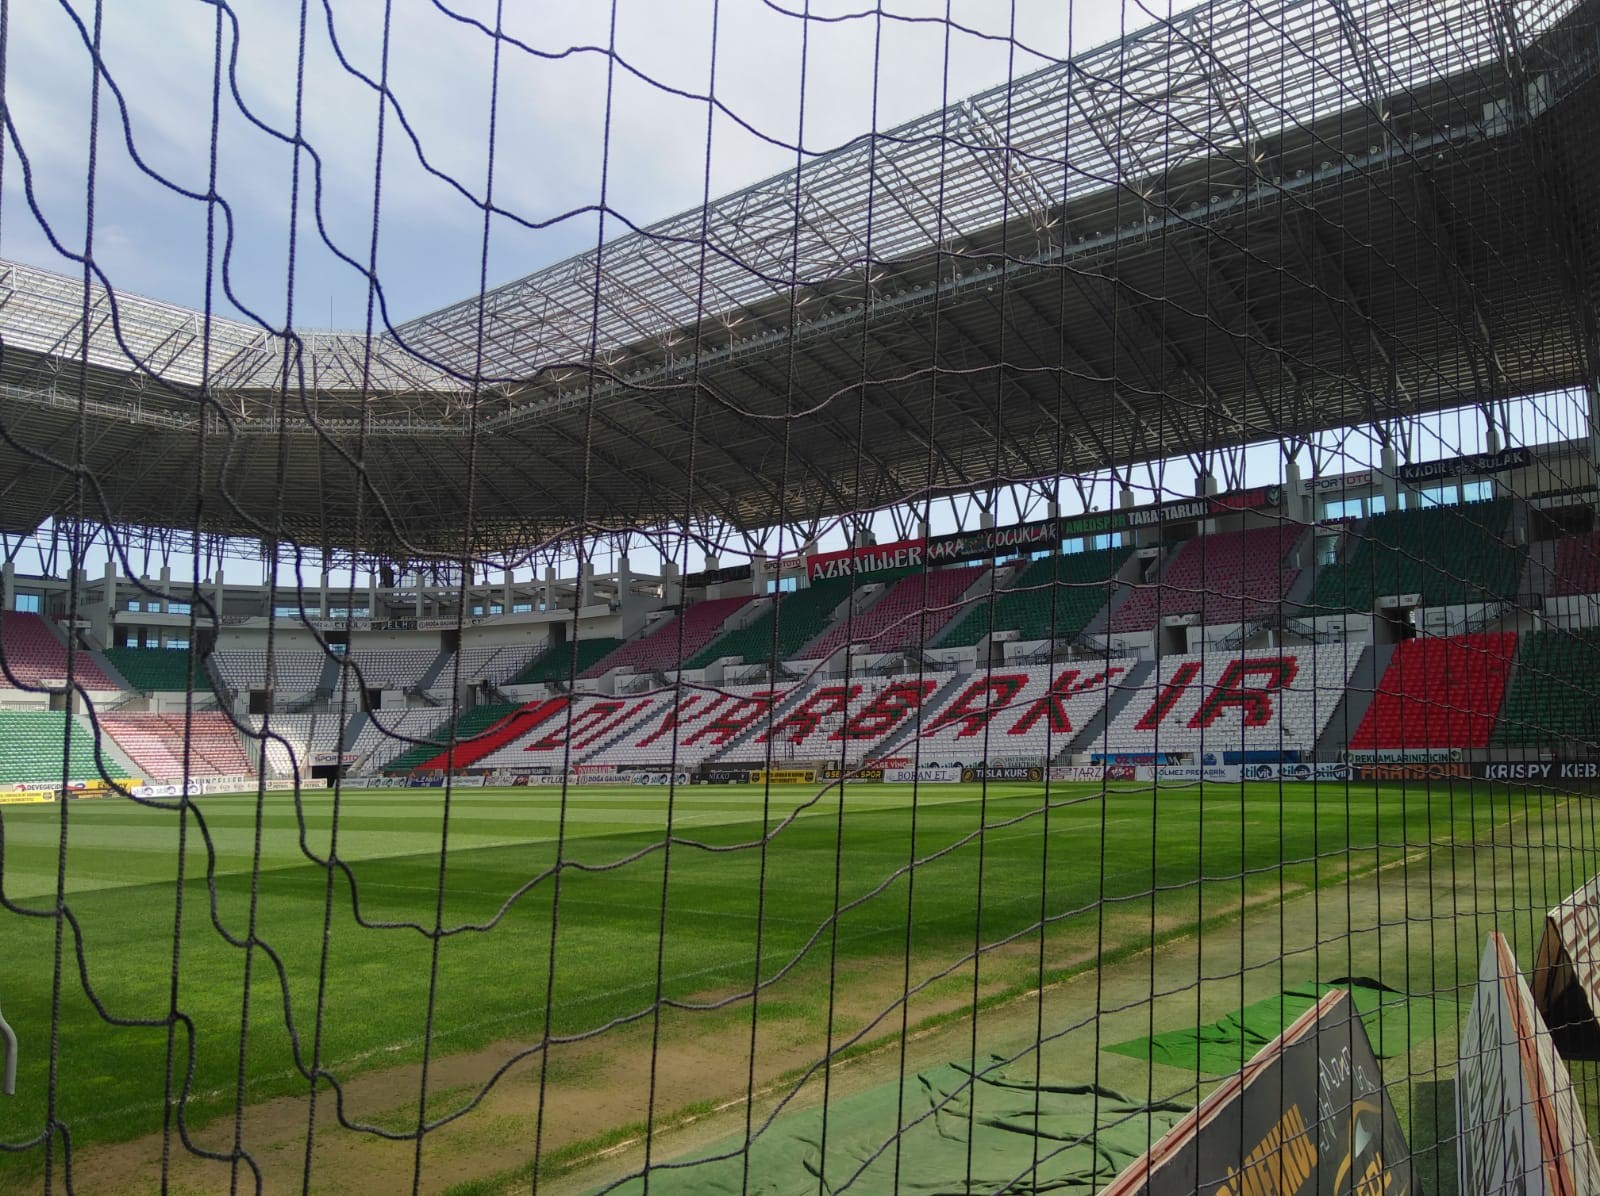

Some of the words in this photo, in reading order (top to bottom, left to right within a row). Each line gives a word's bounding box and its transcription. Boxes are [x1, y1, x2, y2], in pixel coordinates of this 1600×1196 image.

[1304, 478, 1338, 491] SPOR
[1339, 474, 1372, 486] OTO
[928, 538, 964, 559] KARA
[764, 562, 780, 570] SPO
[860, 770, 881, 779] SPOR
[1004, 768, 1028, 778] KURS
[1073, 766, 1103, 778] TARZ
[1485, 764, 1552, 779] KRISPY
[1560, 763, 1600, 779] KEB
